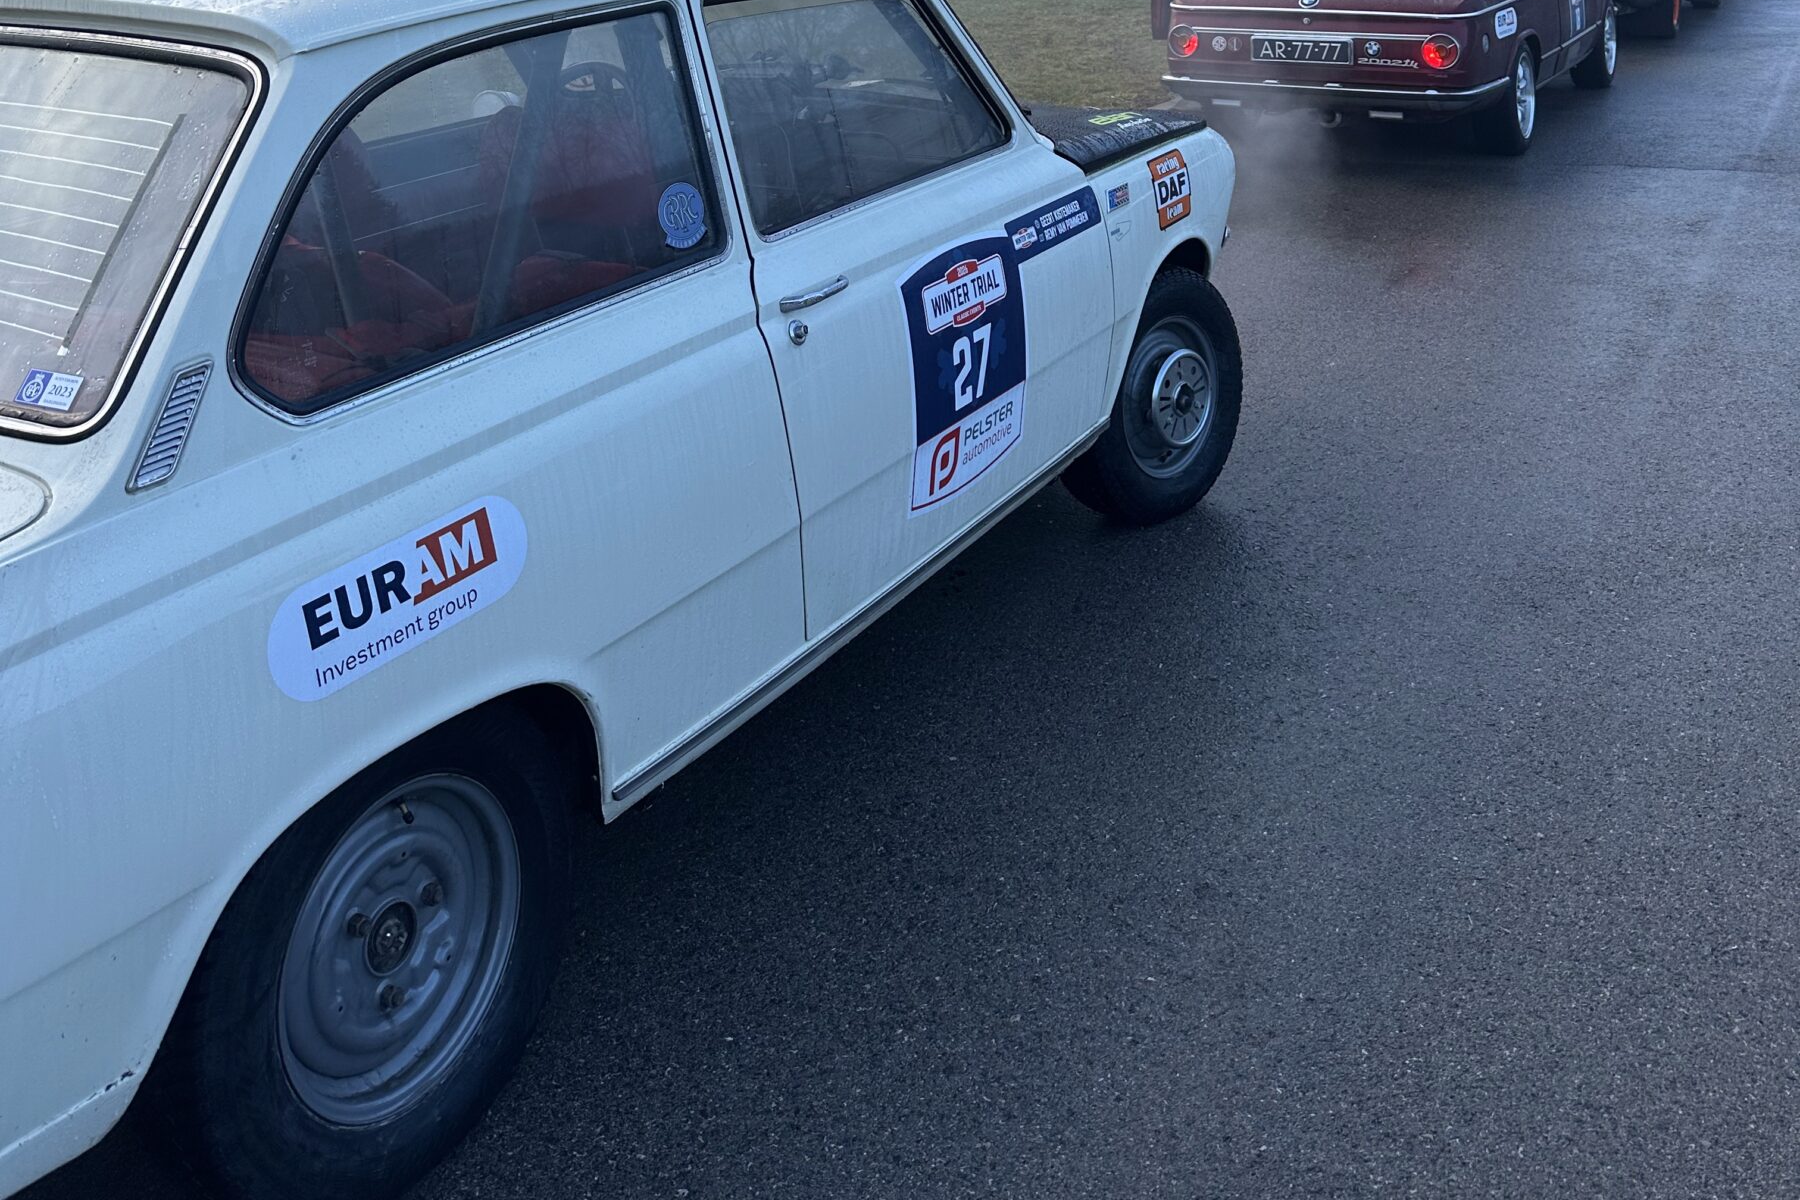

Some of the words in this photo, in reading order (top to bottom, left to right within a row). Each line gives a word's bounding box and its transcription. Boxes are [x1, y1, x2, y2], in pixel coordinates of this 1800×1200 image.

[1156, 156, 1180, 175] racing
[1157, 171, 1186, 205] DAF
[1166, 202, 1184, 220] team
[930, 282, 970, 319] WINTER
[970, 269, 1000, 298] TRIAL
[953, 323, 992, 412] 27
[47, 384, 75, 398] 2023
[962, 422, 1013, 465] automotive
[964, 400, 1014, 446] PELSTER
[301, 512, 490, 651] EURAM
[315, 615, 424, 688] Investment
[428, 587, 479, 631] group
